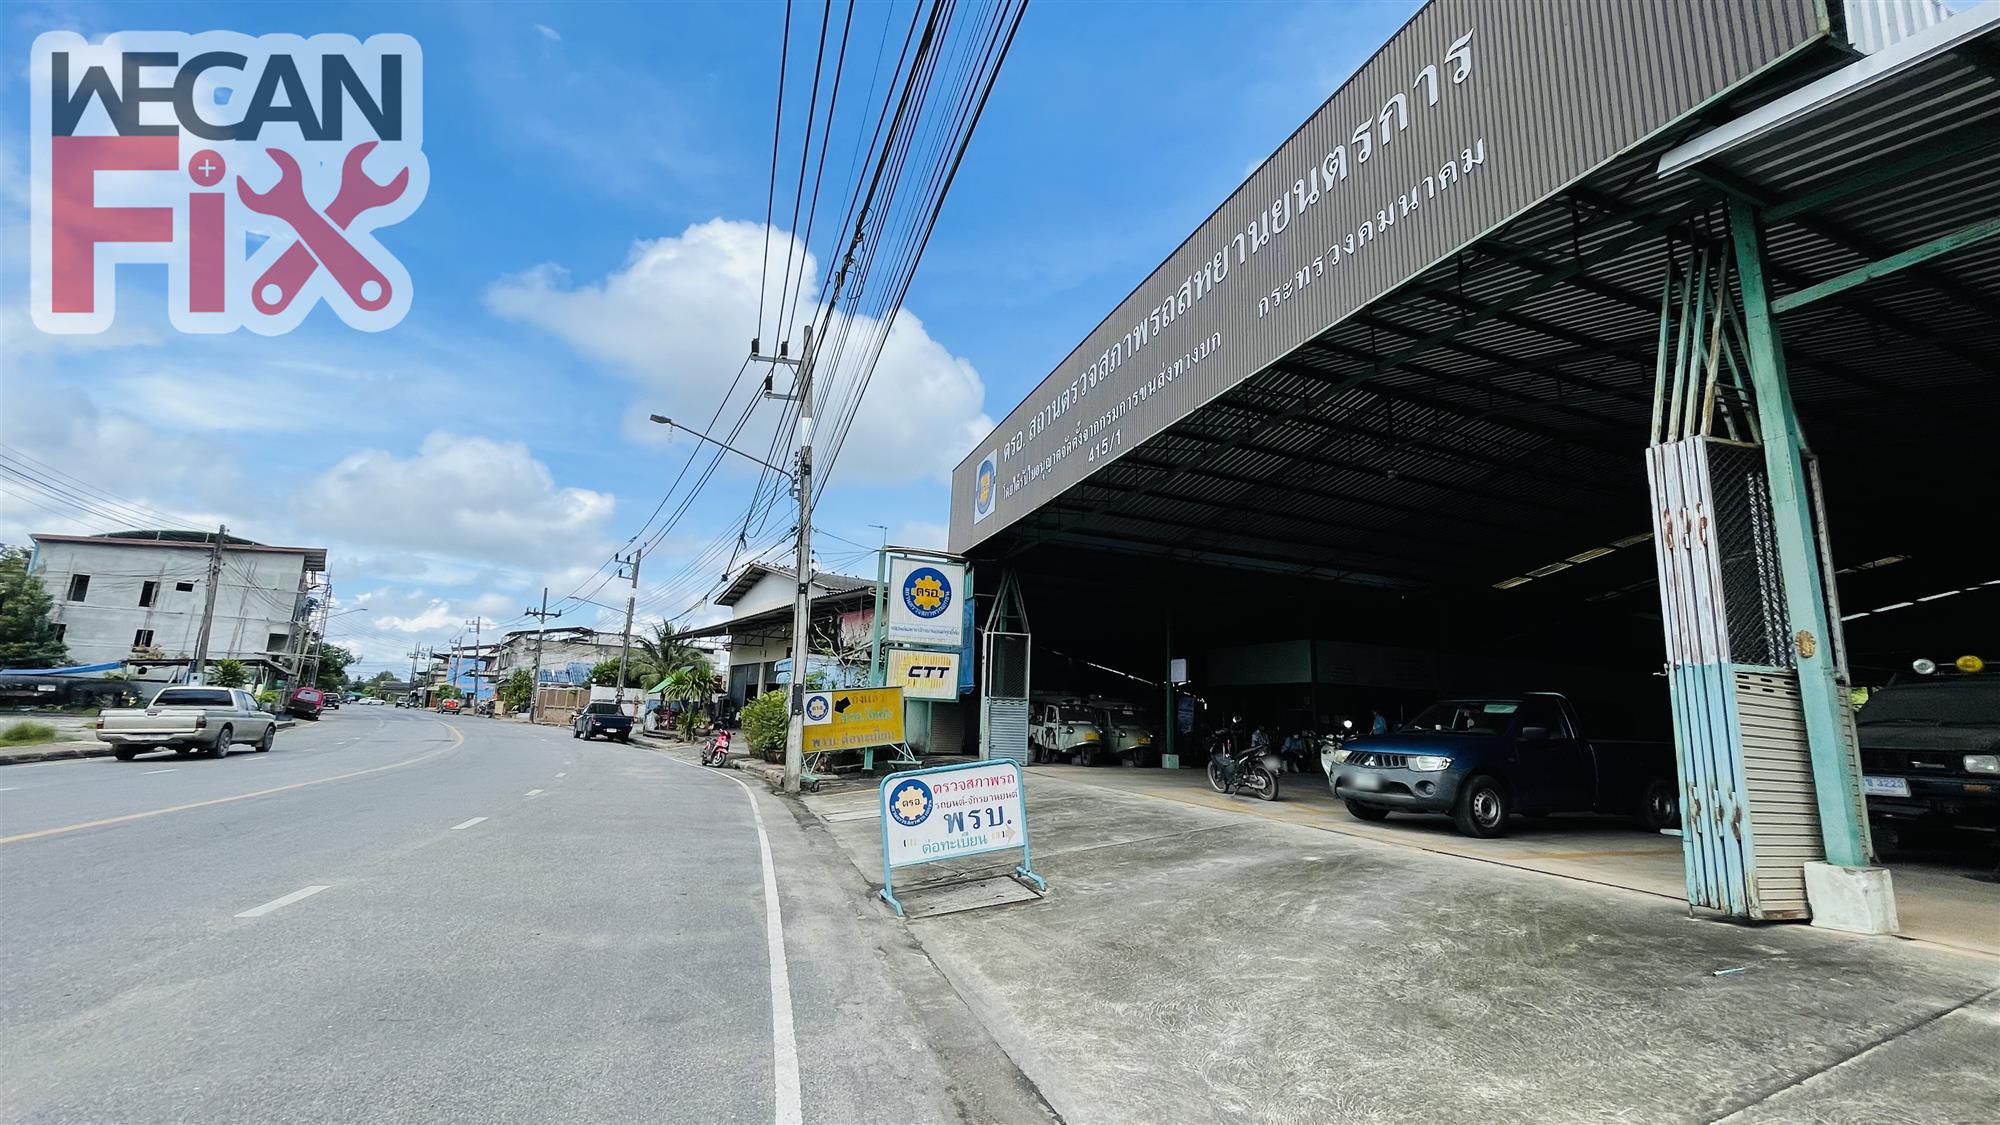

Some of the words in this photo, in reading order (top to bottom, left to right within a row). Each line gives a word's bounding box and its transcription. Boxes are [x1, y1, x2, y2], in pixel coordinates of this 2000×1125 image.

[1258, 137, 1485, 319] กระทรวงคมนาคม
[1087, 428, 1121, 463] 415/1
[908, 665, 950, 678] CTT
[933, 773, 1015, 795] ตรวจสภาพรถ
[944, 806, 1012, 833] พรบ.
[922, 832, 988, 854] ต่อทะเบียน
